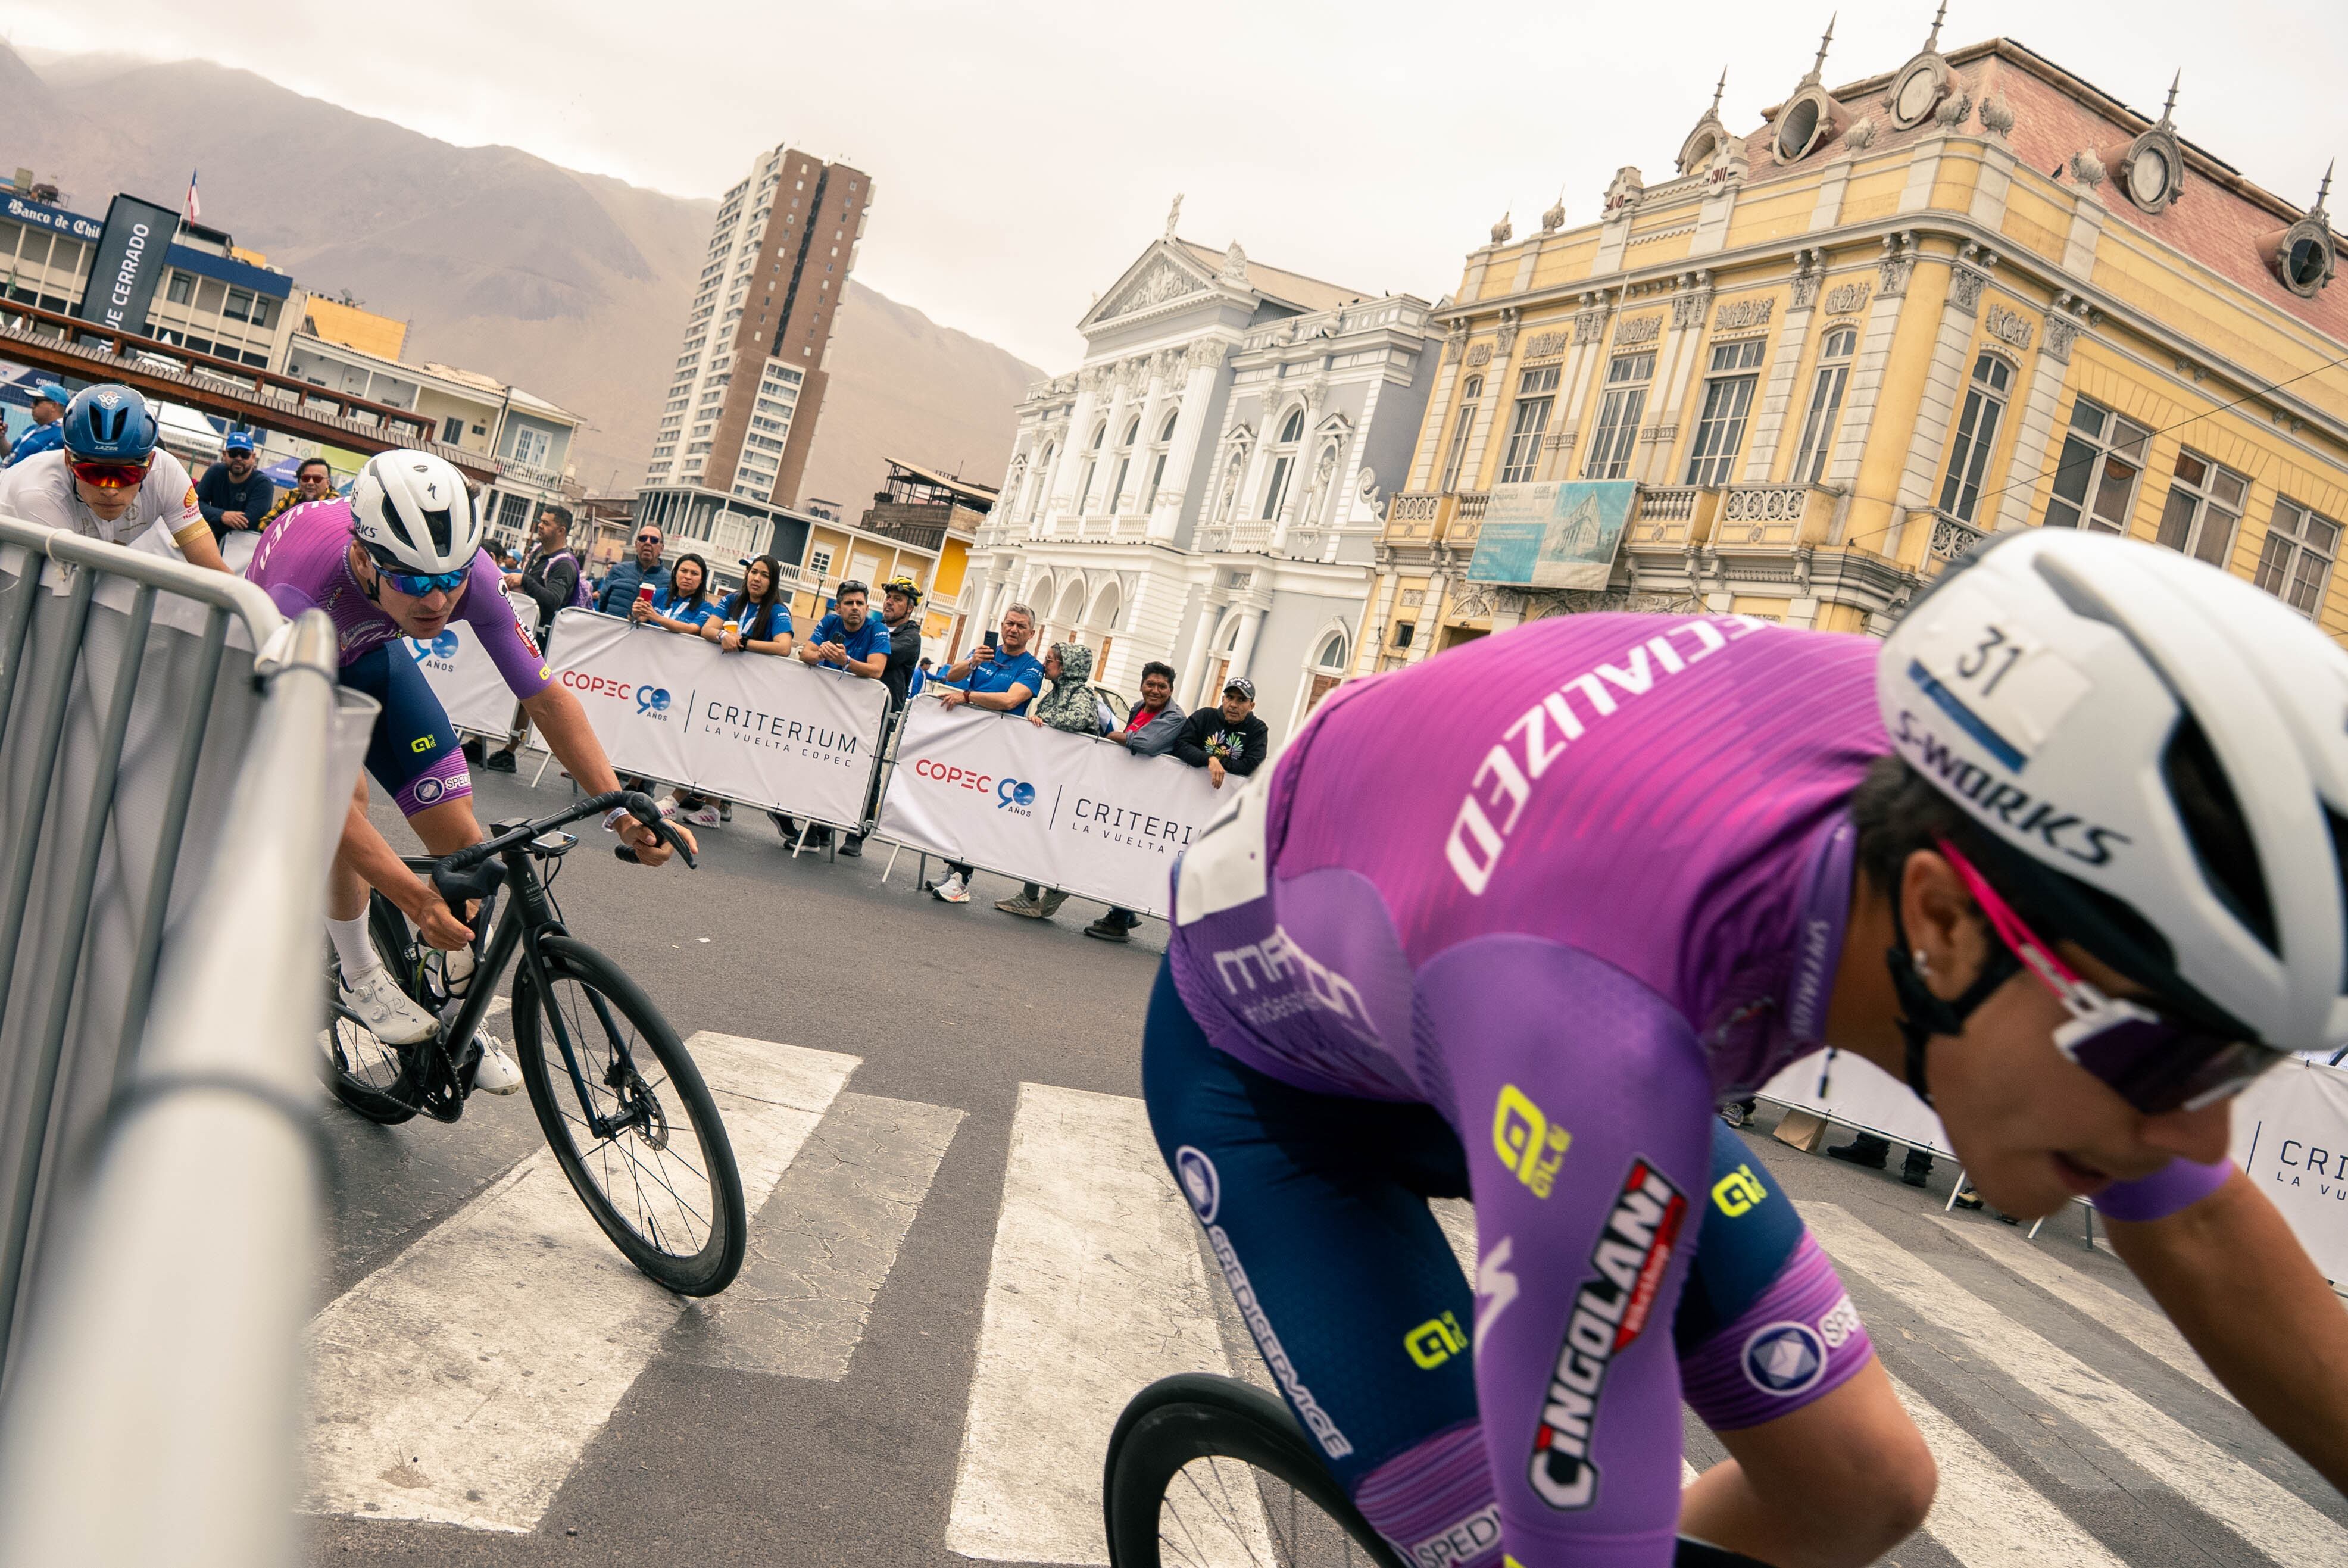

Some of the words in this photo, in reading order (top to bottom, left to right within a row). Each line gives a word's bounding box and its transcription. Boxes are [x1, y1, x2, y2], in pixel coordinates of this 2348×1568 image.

[8, 199, 51, 224] Banco
[54, 214, 69, 230] de
[73, 219, 101, 239] Chil
[111, 223, 149, 306] CERRADO
[352, 520, 377, 538] RKS
[426, 660, 454, 672] AÑOS
[1956, 625, 2022, 698] 31
[563, 671, 631, 700] COPEC
[647, 711, 667, 721] AÑOS
[707, 702, 857, 754] CRITERIUM
[705, 724, 721, 735] LA
[733, 732, 789, 752] VUELTA
[802, 749, 851, 767] COPEC
[916, 759, 992, 793] COPEC
[1894, 710, 2134, 869] S-WORKS
[1008, 806, 1031, 817] AÑOS
[1075, 798, 1201, 845] CRITERI
[1072, 822, 1089, 833] LA
[1103, 830, 1164, 854] VUELTA
[2277, 1171, 2300, 1187] LA
